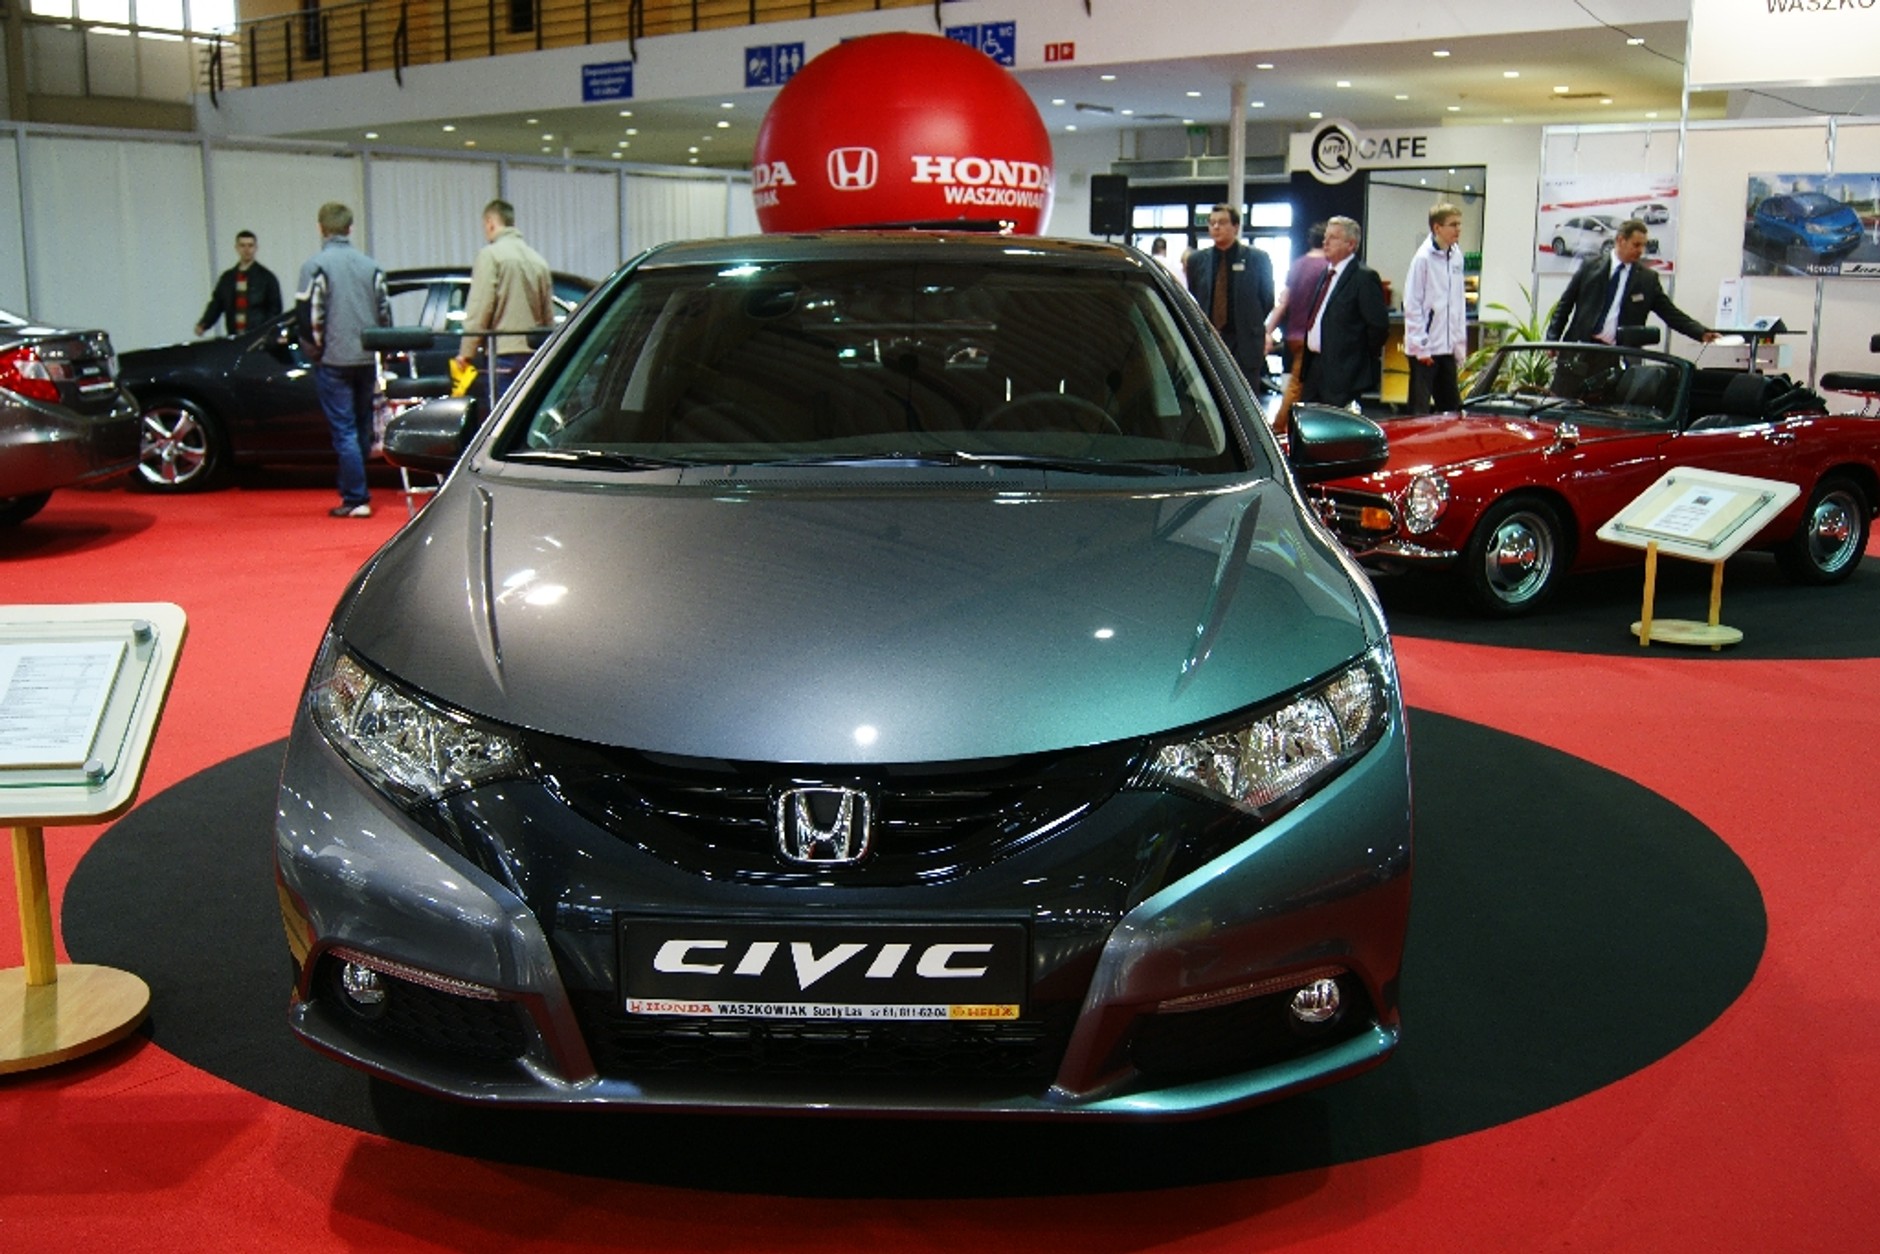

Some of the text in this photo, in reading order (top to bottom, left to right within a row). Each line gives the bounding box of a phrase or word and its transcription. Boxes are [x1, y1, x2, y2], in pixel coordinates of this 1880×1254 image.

[1359, 136, 1427, 160] CAFE
[911, 155, 1051, 191] HONDA
[653, 939, 995, 991] CIVIC
[646, 1002, 713, 1013] HONDA
[718, 1004, 807, 1016] WASZKOWIAK
